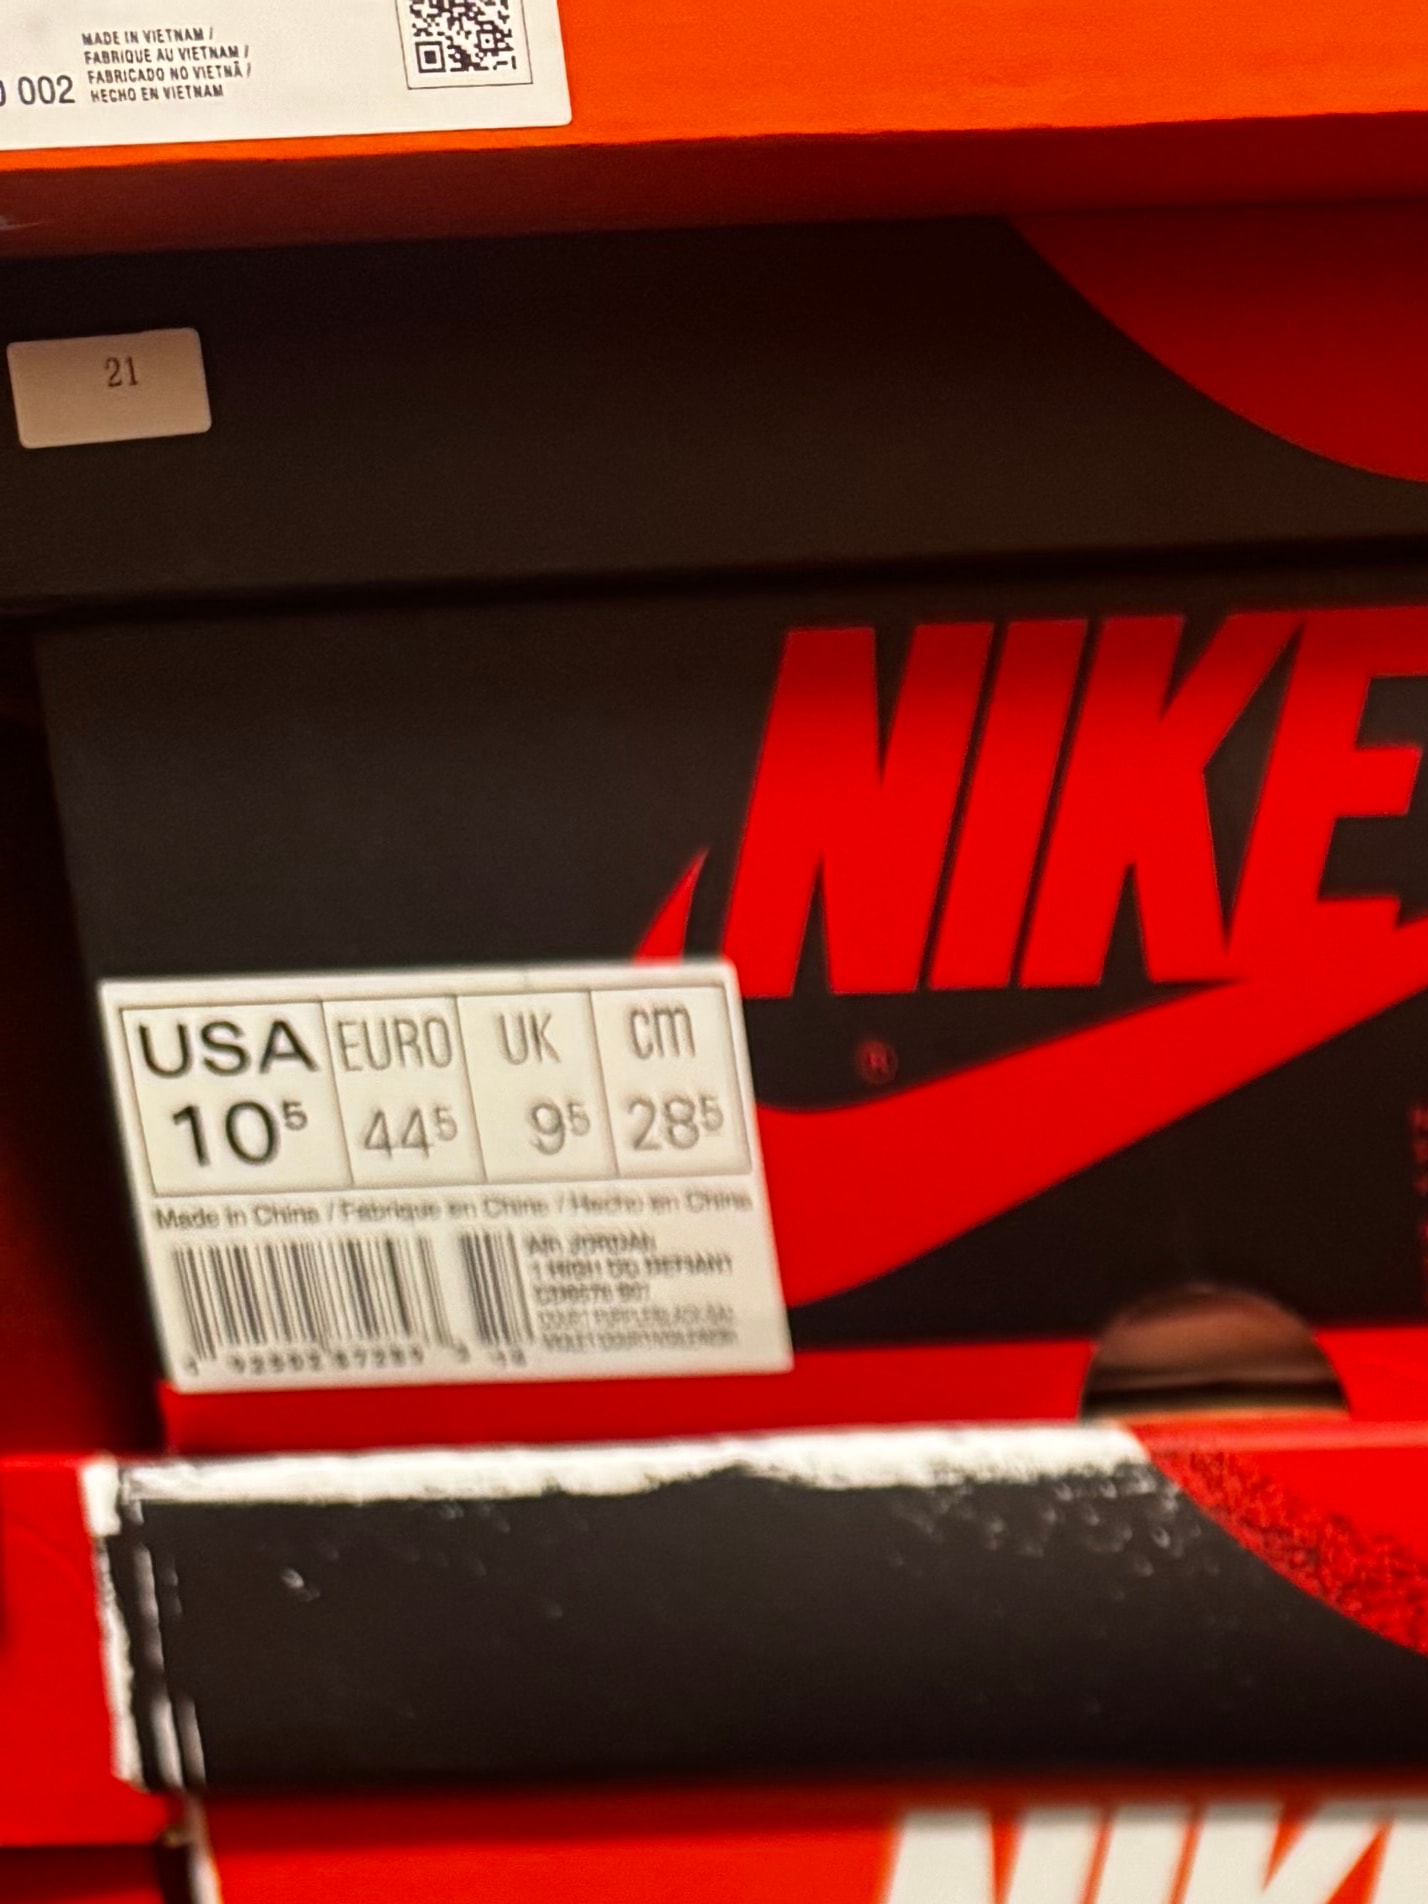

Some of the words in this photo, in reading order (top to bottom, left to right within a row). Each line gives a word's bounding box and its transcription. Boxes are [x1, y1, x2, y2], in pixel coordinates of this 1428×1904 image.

[81, 31, 121, 46] MADE
[124, 31, 139, 44] IN
[143, 27, 204, 43] VIETNAM
[84, 48, 152, 65] FABRIQUE
[156, 47, 174, 62] AU
[178, 46, 240, 61] VIETNAM
[87, 66, 165, 85] FABRICADO
[170, 66, 189, 81] NO
[192, 61, 243, 80] VIETNÃ
[18, 75, 76, 105] 002
[90, 86, 137, 104] HECHO
[141, 86, 159, 101] EN
[162, 84, 224, 99] VIETNAM
[104, 356, 139, 388] 21
[139, 1018, 318, 1079] USA
[336, 1015, 452, 1075] EURO
[500, 1011, 561, 1065] UK
[628, 1002, 696, 1062] cm
[156, 1206, 220, 1230] Made
[225, 1204, 247, 1228] in
[254, 1203, 319, 1226] China
[340, 1200, 442, 1226] Fabrique
